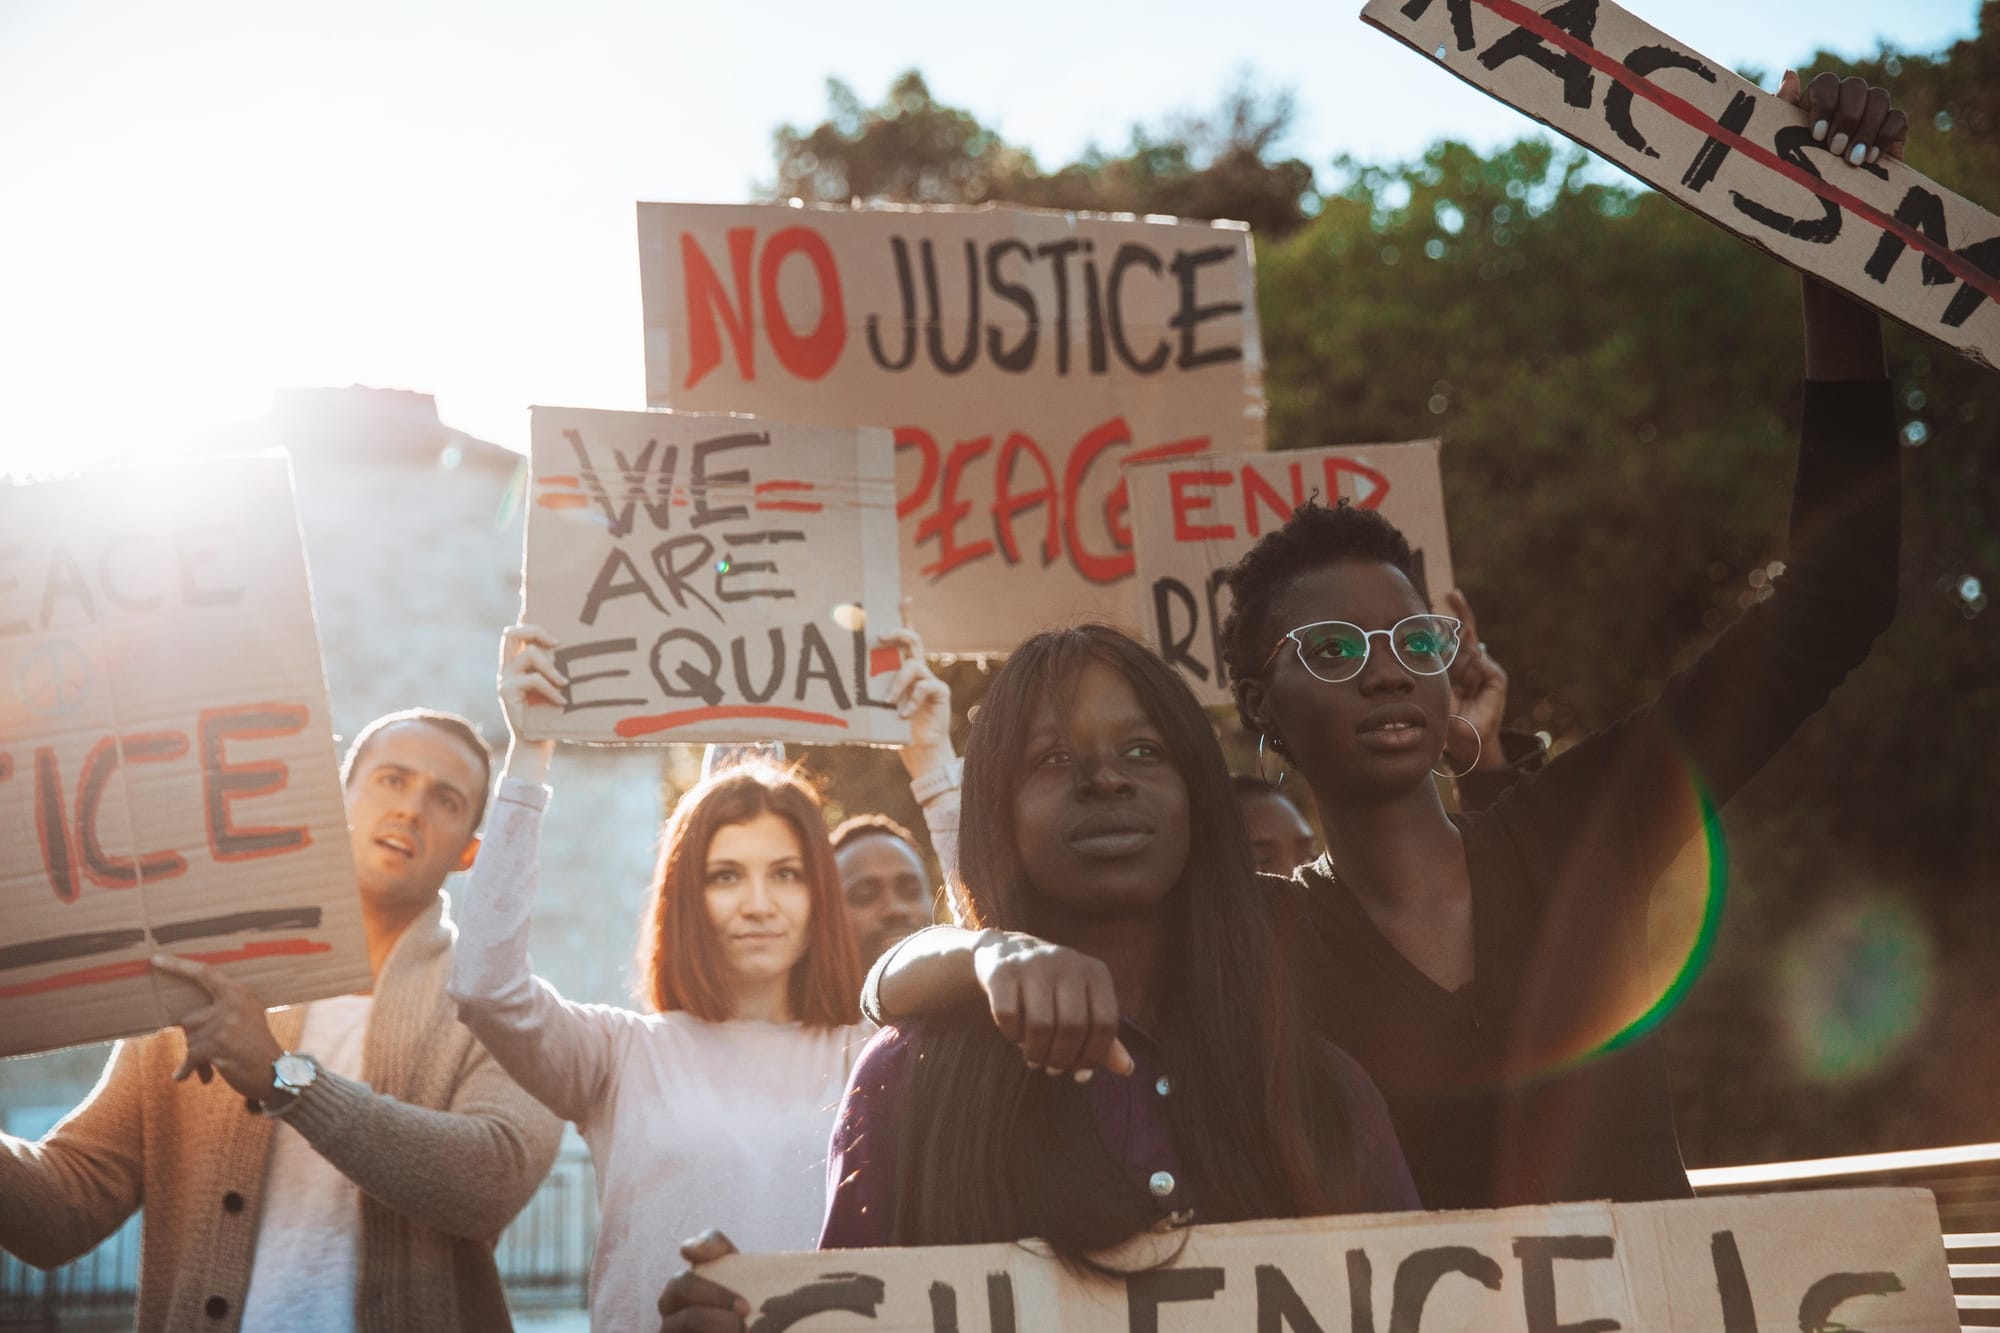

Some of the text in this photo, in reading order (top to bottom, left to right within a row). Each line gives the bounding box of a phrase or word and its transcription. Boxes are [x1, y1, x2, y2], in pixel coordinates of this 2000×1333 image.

[681, 226, 848, 390] NO
[562, 428, 771, 539] WE
[893, 416, 1211, 584] PEAC
[579, 530, 806, 626] ARE
[553, 602, 899, 715] EQUAL
[0, 701, 312, 904] ICE
